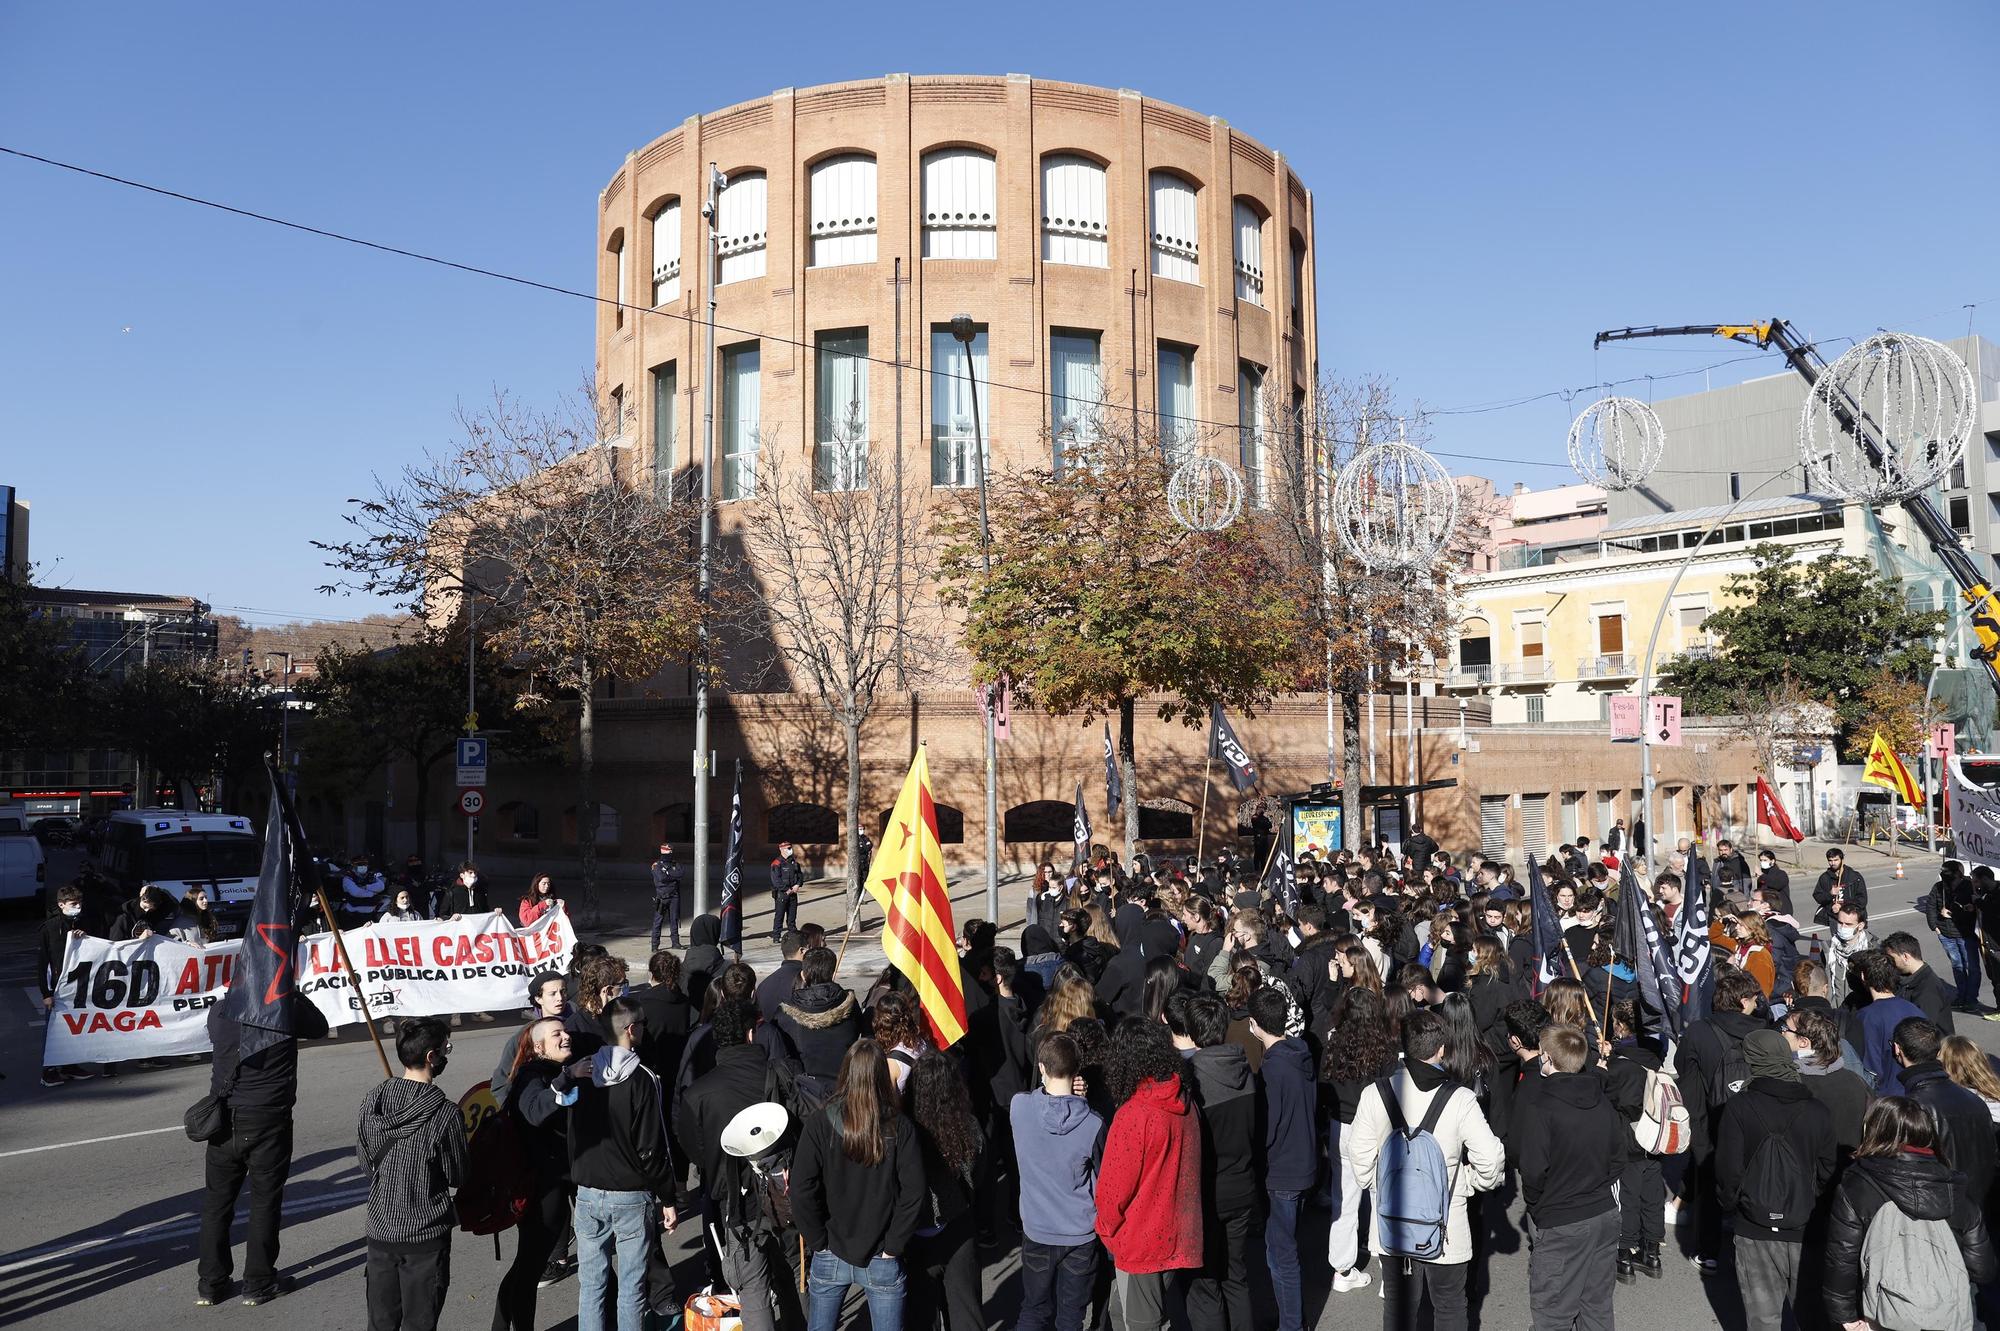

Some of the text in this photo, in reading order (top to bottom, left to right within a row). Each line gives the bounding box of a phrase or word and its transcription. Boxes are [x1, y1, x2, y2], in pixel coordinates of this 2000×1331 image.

[463, 741, 481, 765] P
[464, 797, 480, 808] 30
[66, 960, 160, 1009] 16D
[175, 952, 241, 995] ATU
[364, 936, 423, 968] LLEI
[173, 995, 218, 1012] PER
[367, 965, 449, 983] PÚBLICA
[451, 969, 459, 980] I
[462, 966, 488, 979] DE
[491, 953, 565, 979] QUALITAT
[62, 1009, 164, 1036] VAGA
